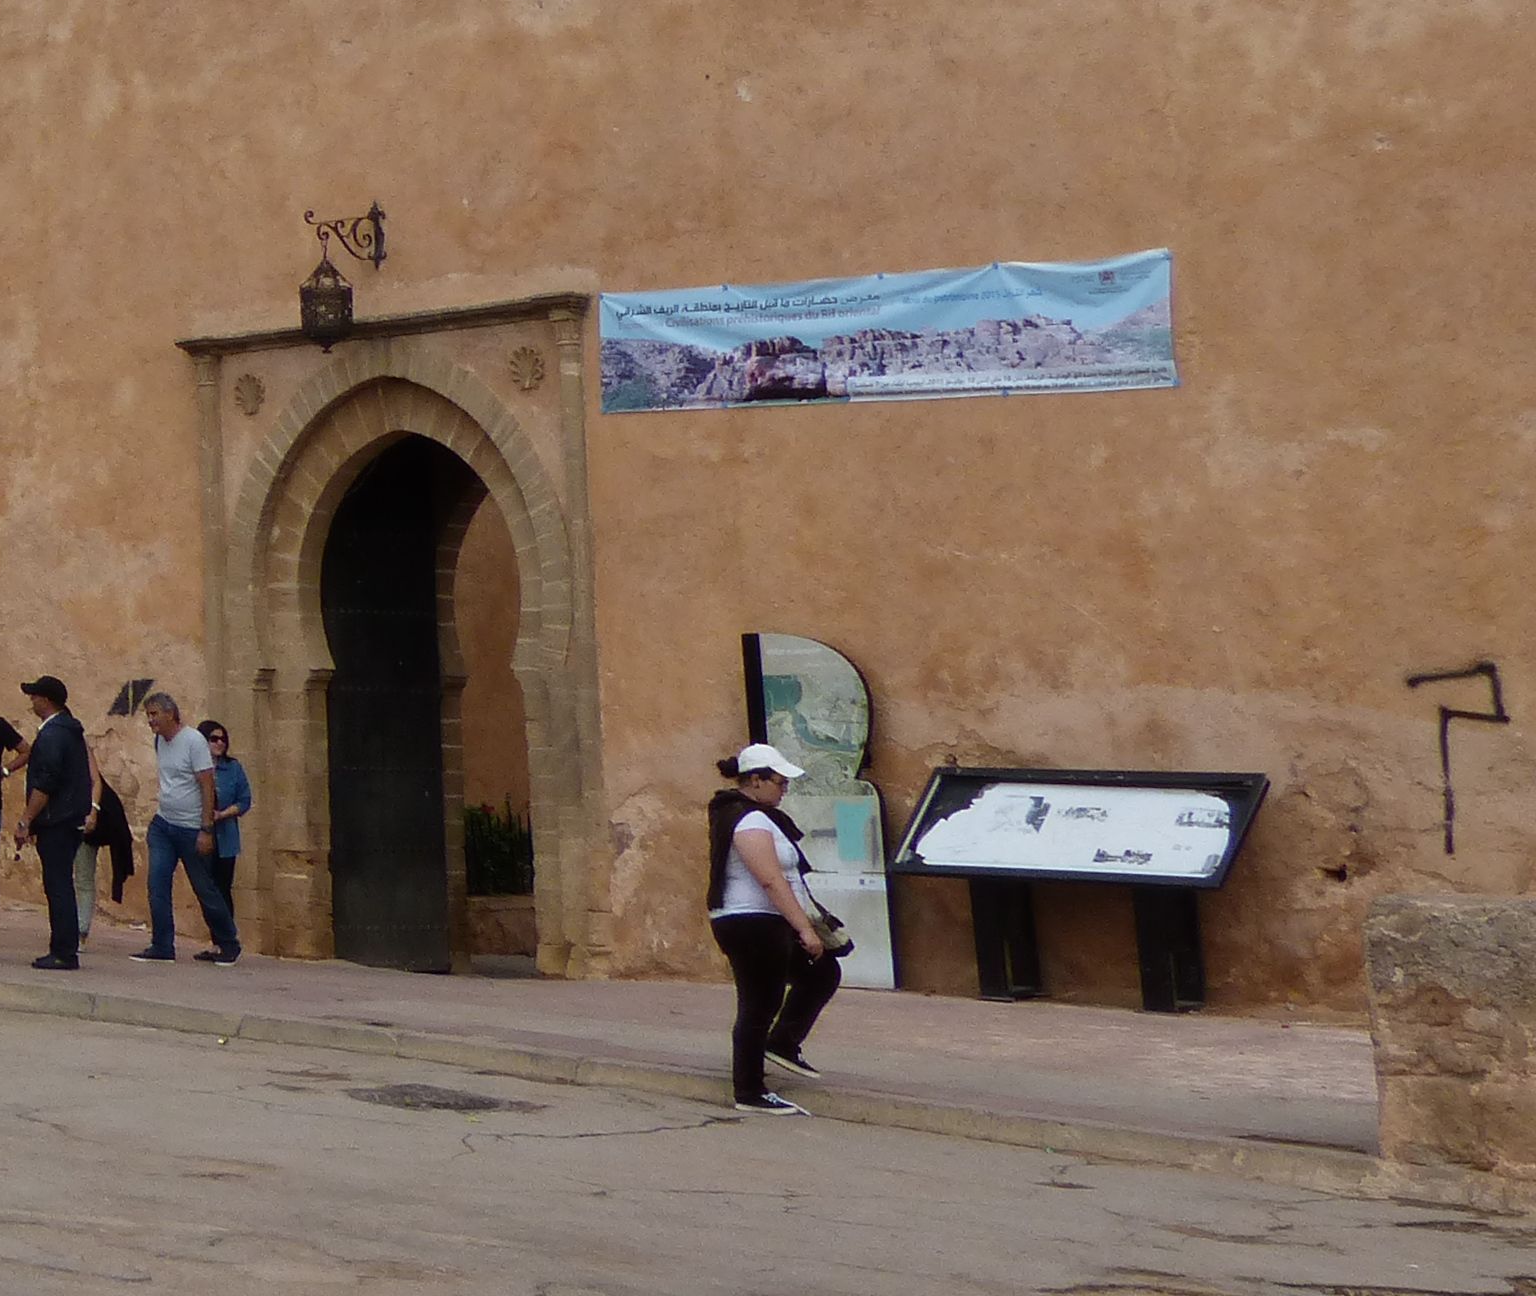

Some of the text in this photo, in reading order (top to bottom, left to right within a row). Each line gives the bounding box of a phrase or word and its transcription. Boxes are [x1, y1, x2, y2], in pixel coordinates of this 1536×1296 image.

[615, 293, 881, 321] معرض حضارات ما قبل التاريخ بمنطقة الريف الشرقي
[665, 315, 725, 329] Civilisations
[805, 309, 819, 320] du
[821, 307, 837, 319] Rif
[838, 306, 880, 318] oriental
